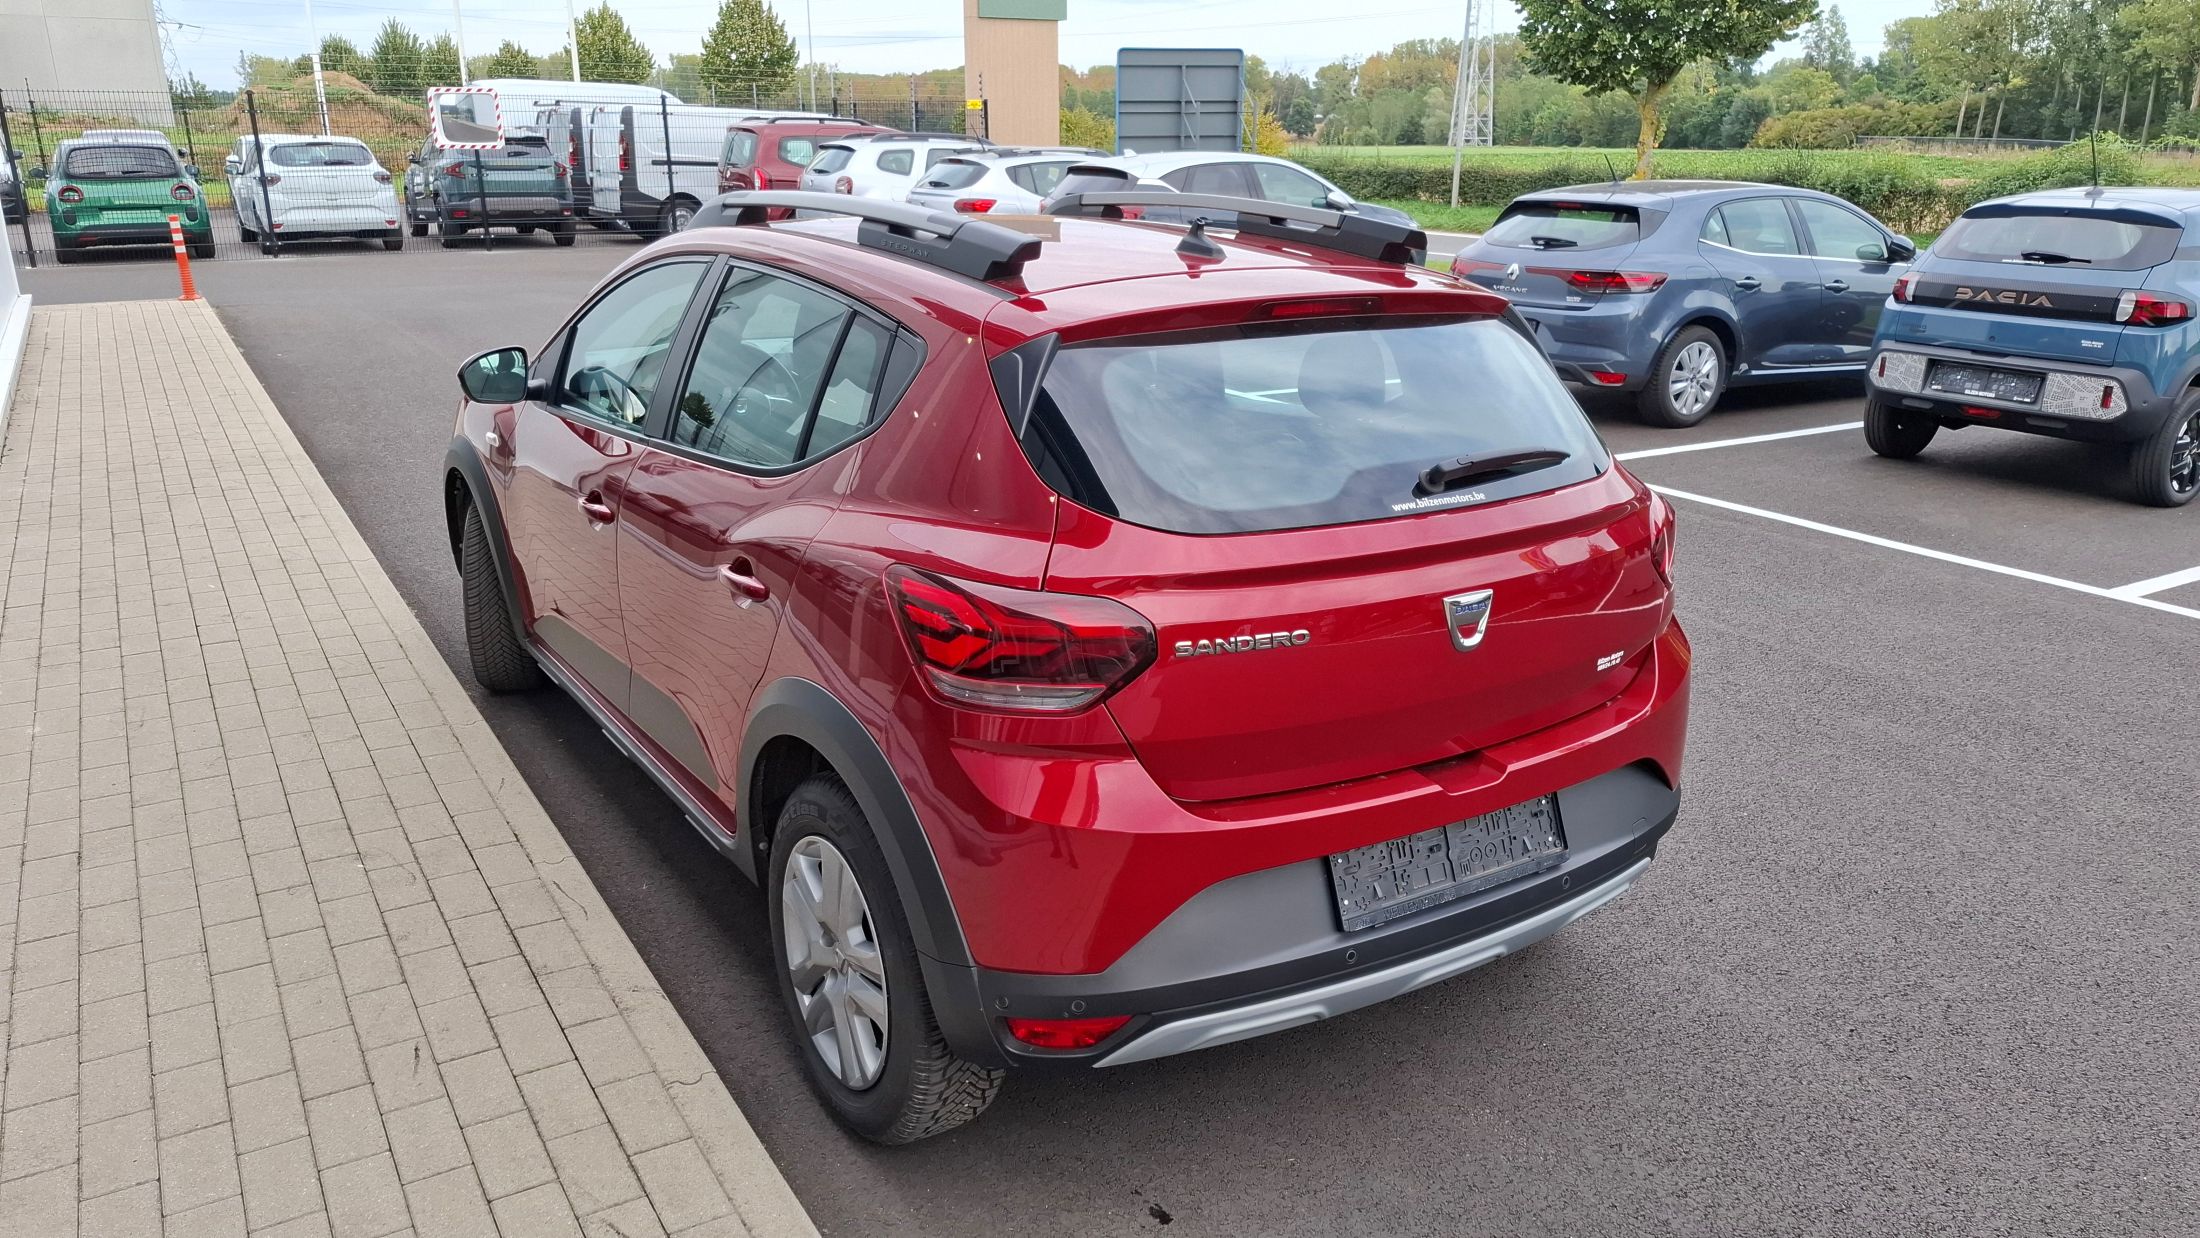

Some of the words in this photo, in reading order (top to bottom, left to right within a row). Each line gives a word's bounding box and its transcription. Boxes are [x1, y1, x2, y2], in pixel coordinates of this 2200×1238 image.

[881, 239, 929, 257] STEPWAY
[1954, 287, 2053, 308] DACIA
[1392, 492, 1486, 512] www.bilzenmotors.be
[1455, 600, 1490, 616] DACIA
[1174, 629, 1311, 658] SANDERO
